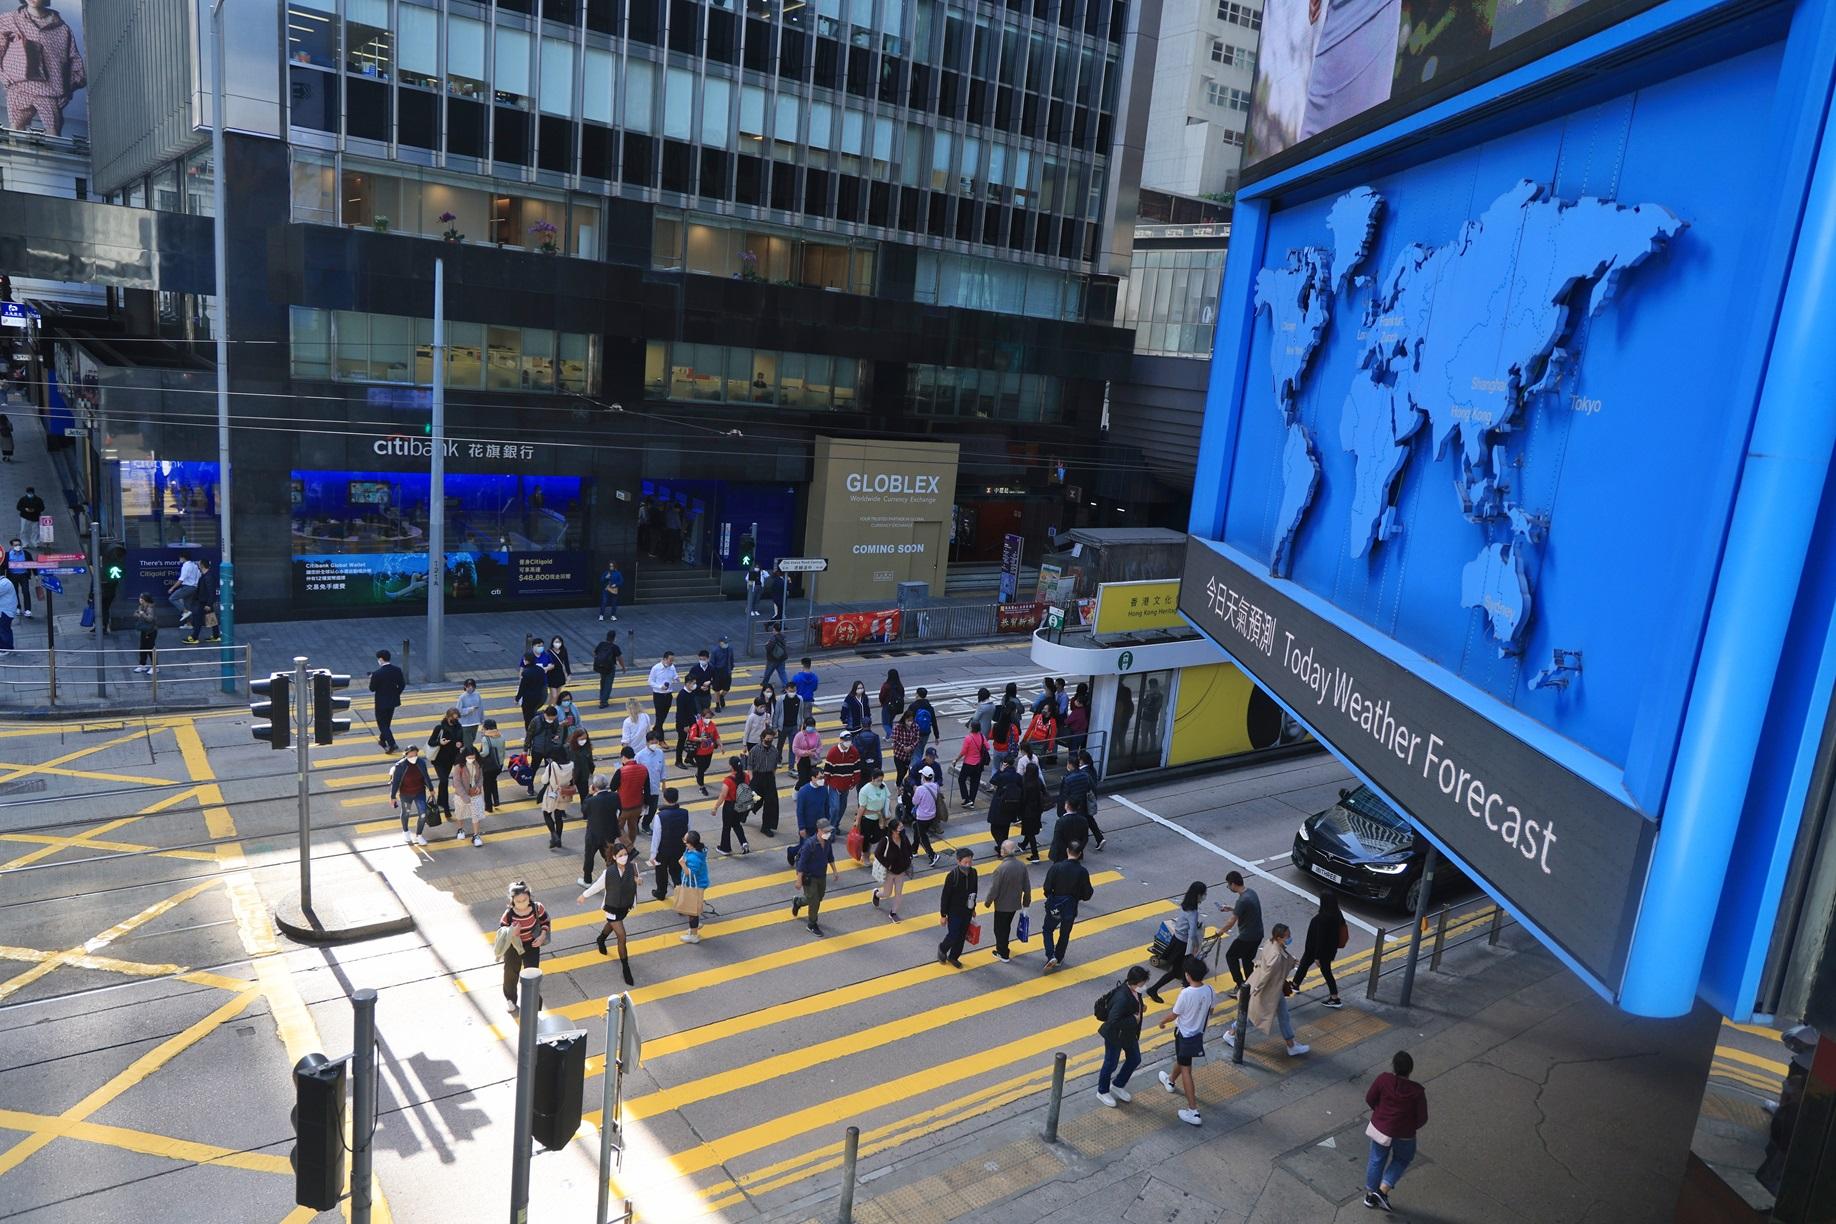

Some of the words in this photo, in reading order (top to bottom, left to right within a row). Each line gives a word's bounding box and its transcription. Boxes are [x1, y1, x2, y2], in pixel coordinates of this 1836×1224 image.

[1570, 395, 1602, 415] Tokyo
[1472, 408, 1493, 425] Kong
[373, 438, 459, 457] citibak
[468, 443, 534, 460] 花旗銀行
[846, 473, 940, 494] GLOBLEX
[883, 496, 908, 504] Currency
[910, 496, 936, 504] Exchange
[852, 545, 894, 554] COMING
[897, 544, 925, 553] SOON
[140, 570, 166, 578] Citigold
[1131, 595, 1178, 607] 香港文化
[1128, 609, 1142, 617] Hong
[1206, 575, 1277, 657] 今日天氣預測
[1283, 630, 1333, 706] Today
[1334, 667, 1422, 766] Weather
[1422, 733, 1558, 875] Forecast
